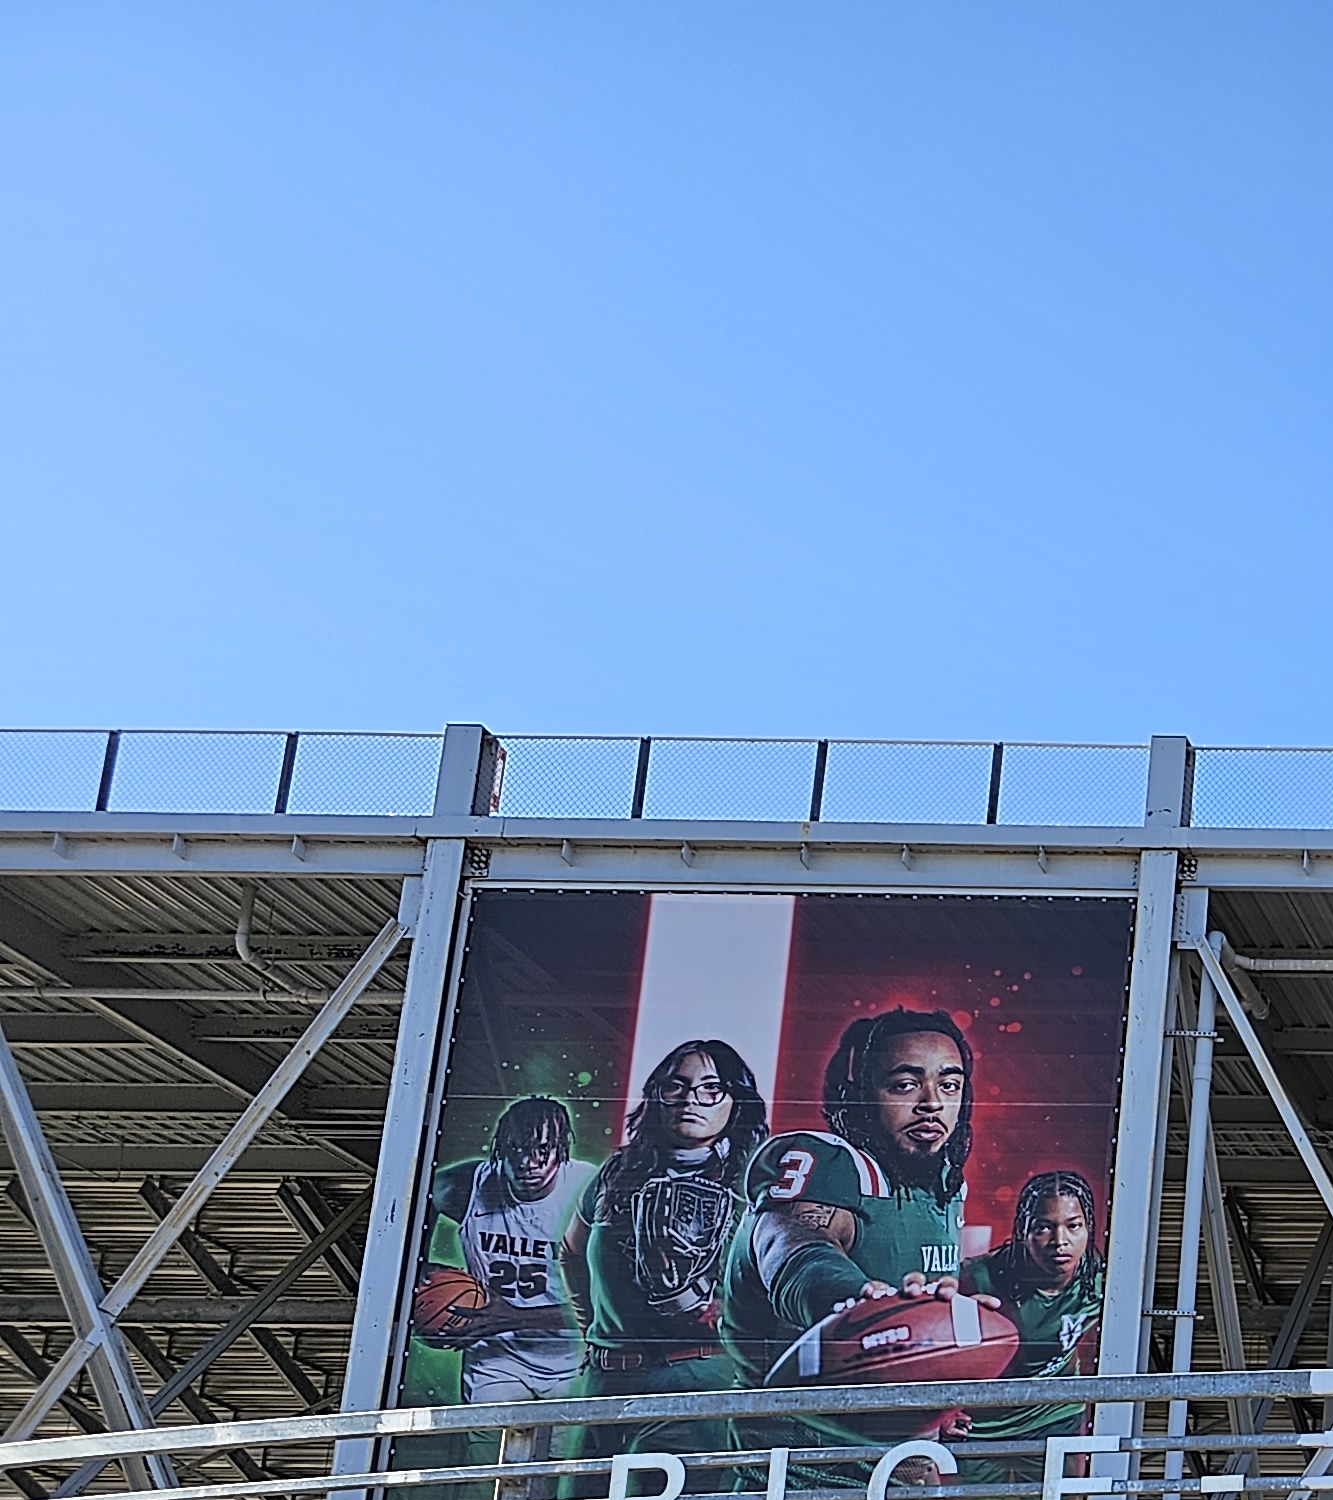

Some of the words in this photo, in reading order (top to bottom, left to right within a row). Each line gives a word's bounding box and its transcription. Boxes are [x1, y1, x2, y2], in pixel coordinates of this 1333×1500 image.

[767, 1149, 817, 1201] 3
[478, 1231, 563, 1261] VALLEY
[488, 1260, 548, 1300] 25
